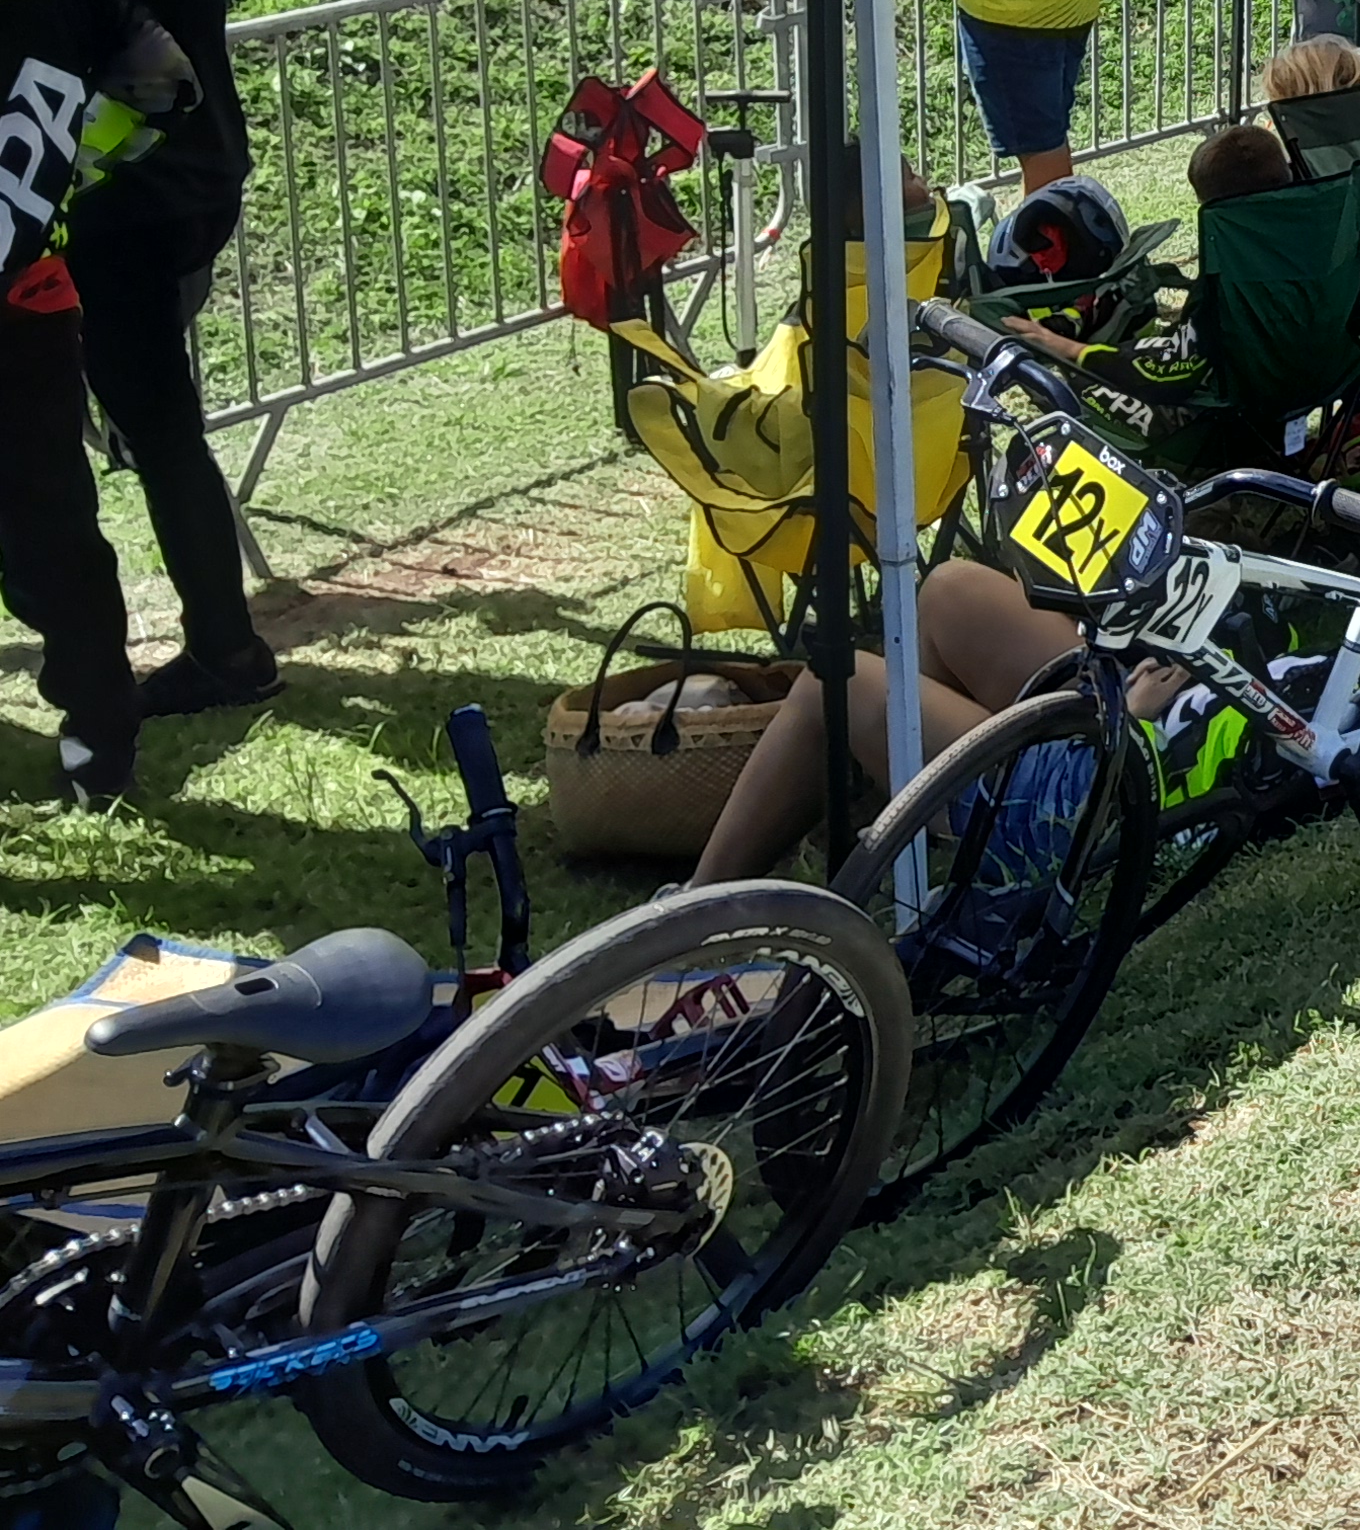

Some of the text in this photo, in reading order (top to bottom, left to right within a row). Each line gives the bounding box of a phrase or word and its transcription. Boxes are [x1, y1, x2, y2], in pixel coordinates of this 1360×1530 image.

[1099, 445, 1127, 475] box
[1032, 467, 1120, 575] 12Y
[1147, 556, 1214, 644] 12Y
